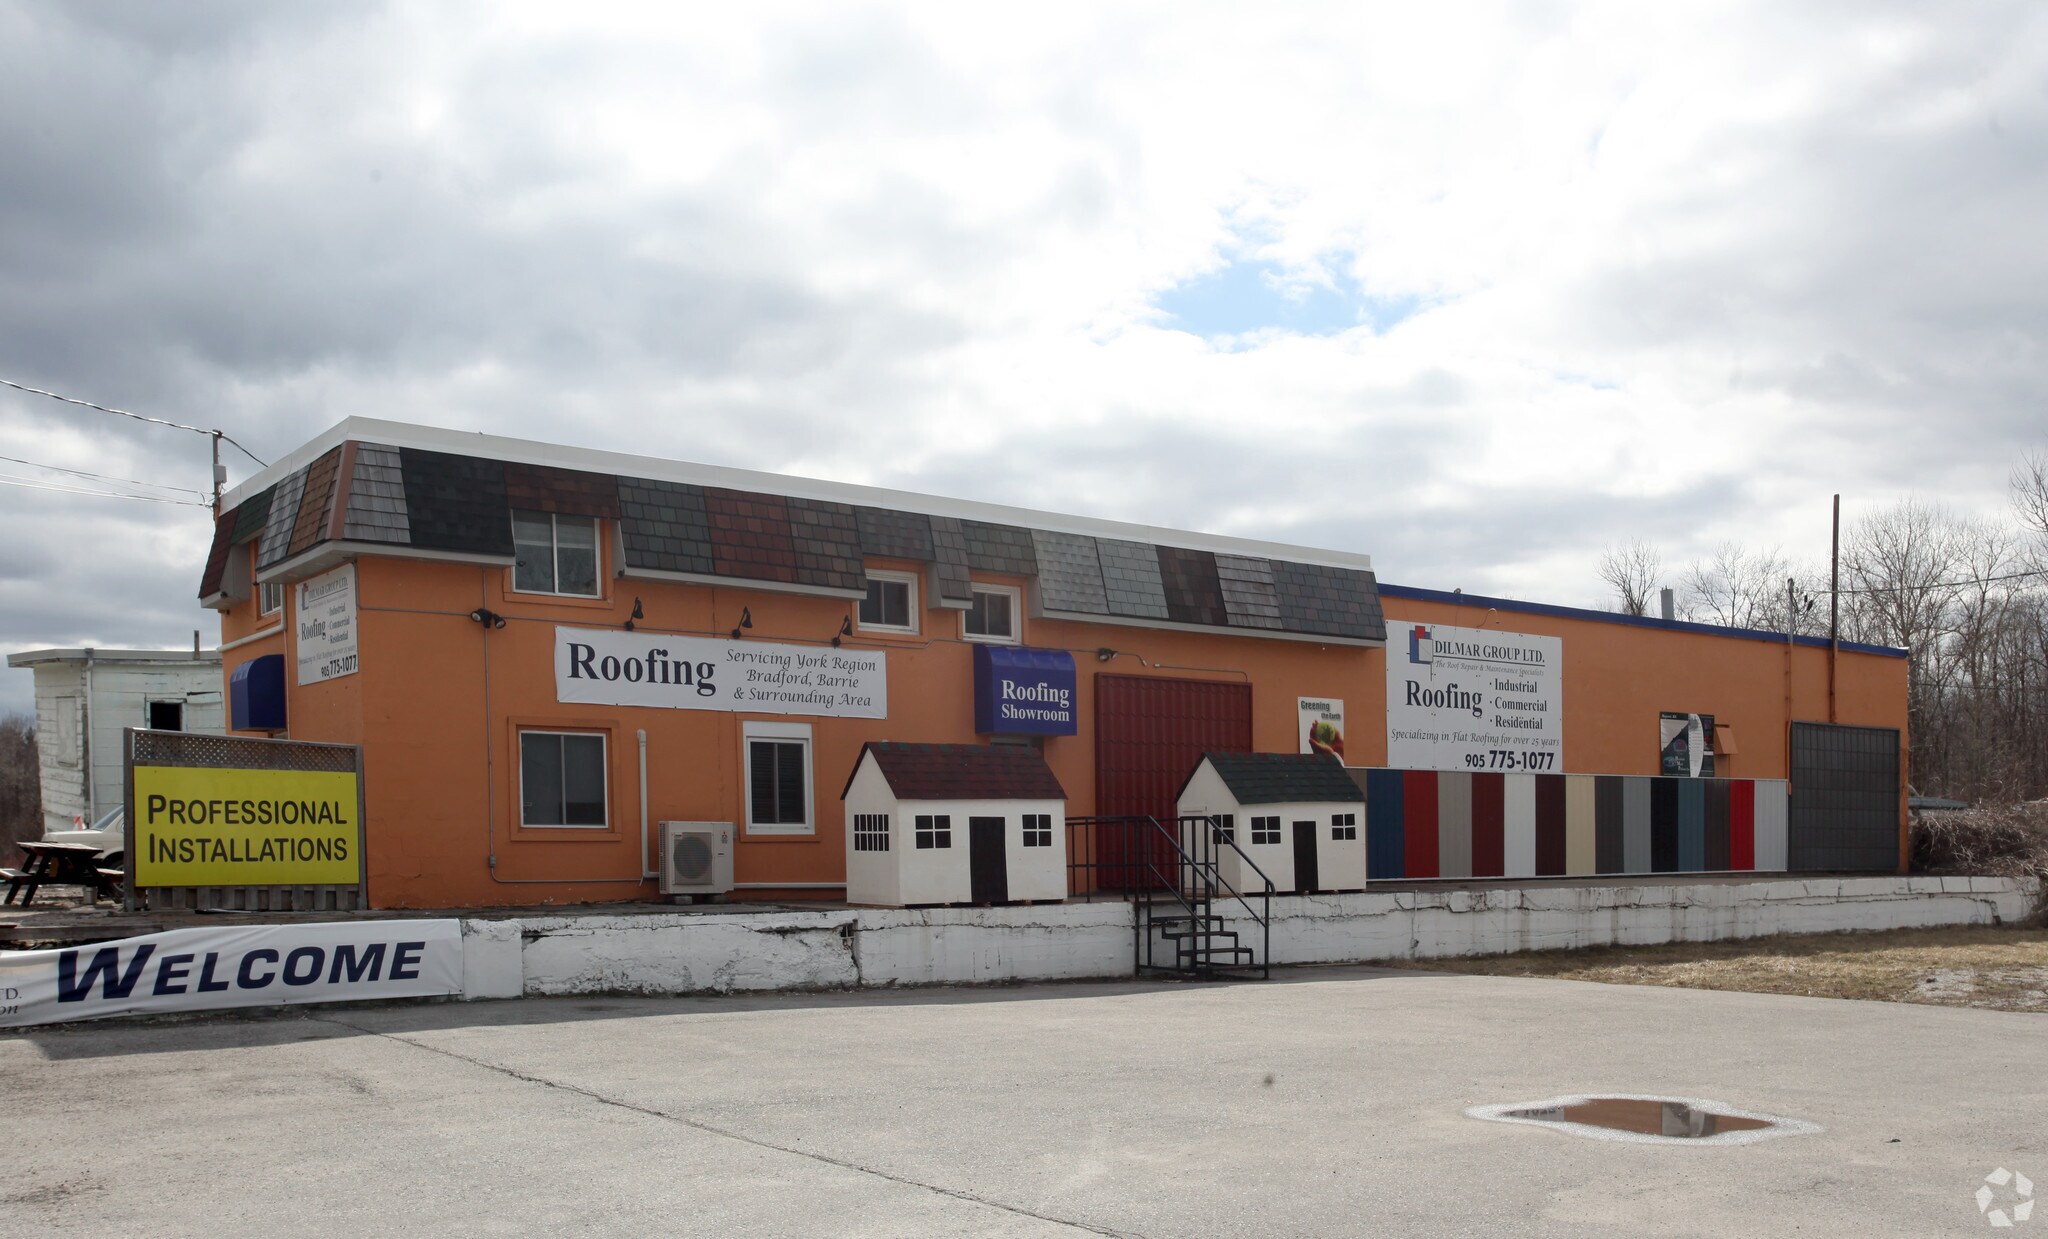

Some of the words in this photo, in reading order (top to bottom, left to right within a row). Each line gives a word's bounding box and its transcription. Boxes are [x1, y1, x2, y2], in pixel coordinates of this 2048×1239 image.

[301, 619, 326, 640] Roofing
[726, 648, 791, 669] Servicing
[797, 653, 827, 669] York
[832, 656, 876, 674] Region
[1434, 640, 1480, 657] DILMAR
[1483, 645, 1520, 660] GROUP
[1523, 649, 1545, 663] LTD.
[321, 666, 330, 677] 905
[330, 654, 356, 675] 775-1077
[566, 642, 717, 697] Roofing
[1435, 660, 1445, 668] The
[1447, 661, 1460, 671] Roof
[1460, 663, 1478, 672] Repair
[1484, 665, 1518, 674] Maintenance
[746, 668, 812, 688] Bradford,
[816, 673, 859, 688] Barrie
[1495, 678, 1538, 694] Industrial
[733, 687, 745, 700] &
[748, 687, 834, 708] Surrounding
[838, 693, 871, 707] Area
[1001, 680, 1070, 708] Roofing
[1405, 679, 1483, 718] Roofing
[1495, 696, 1547, 712] Commercial
[1001, 703, 1070, 722] Showroom
[1300, 700, 1330, 711] Greening
[1495, 715, 1543, 730] Residential
[1391, 728, 1440, 744] Specializing
[1441, 731, 1450, 741] in
[1451, 731, 1467, 744] Flat
[1470, 732, 1499, 747] Roofing
[1499, 733, 1511, 747] for
[1513, 737, 1529, 745] over
[1531, 738, 1539, 747] 25
[1541, 738, 1560, 749] years
[1465, 753, 1485, 768] 905
[1489, 750, 1554, 770] 775-1077
[147, 794, 348, 825] PROFESSIONAL
[149, 834, 348, 863] INSTALLATIONS
[57, 942, 426, 1004] WELCOME
